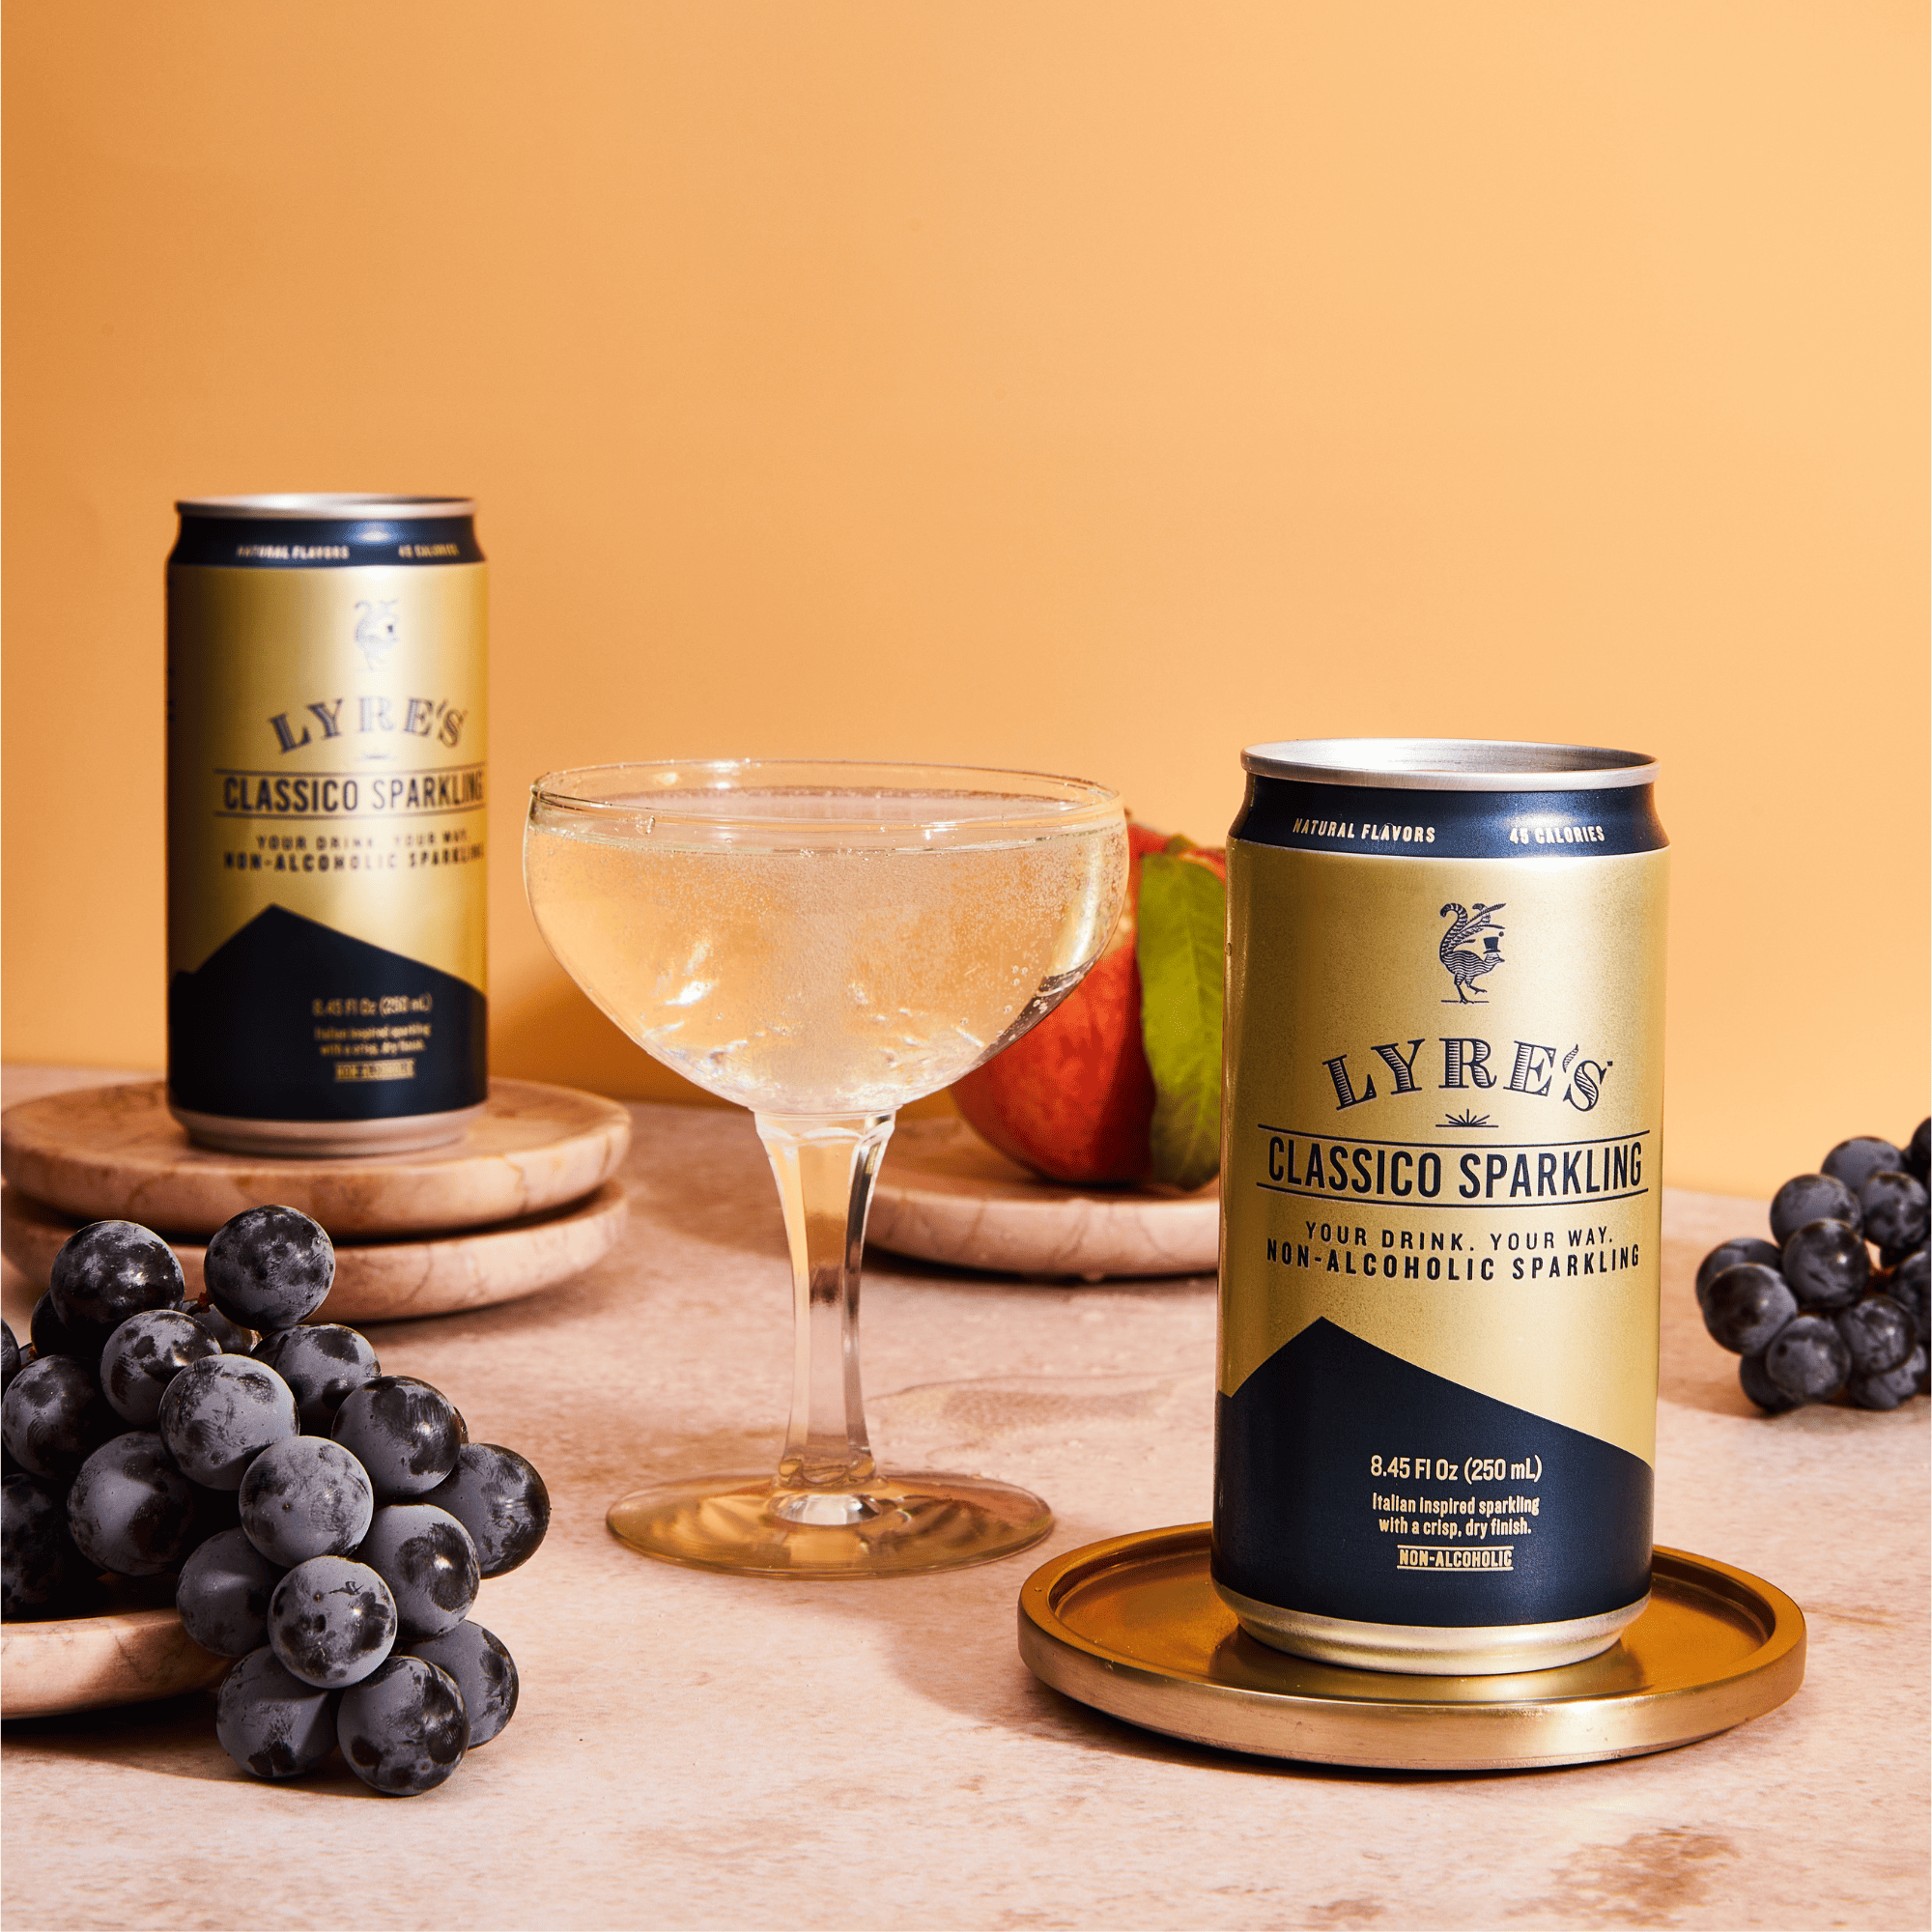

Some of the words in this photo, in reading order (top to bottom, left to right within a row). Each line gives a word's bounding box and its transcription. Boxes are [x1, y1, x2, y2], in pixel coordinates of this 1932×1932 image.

[223, 776, 358, 812] CLASSICO
[372, 770, 483, 810] SPARKLING
[256, 835, 307, 851] YOUR
[393, 830, 436, 847] YOUR
[1293, 817, 1354, 838] NATURAL
[1360, 824, 1435, 843] FLAVORS
[1509, 826, 1528, 844] 45
[1534, 825, 1605, 844] CALORIES
[223, 851, 397, 872] NON-ALCOHOLIC
[409, 842, 483, 867] SPARKL
[1322, 1037, 1607, 1112] LYRE'S
[1268, 1136, 1441, 1199] CLASSICO
[1459, 1141, 1642, 1199] SPARKLING
[1305, 1220, 1367, 1246] YOUR
[1381, 1229, 1474, 1251] DRINK.
[1490, 1231, 1554, 1251] YOUR
[1568, 1225, 1613, 1247] WAY.
[1266, 1237, 1495, 1281] NON-ALCOHOLIC
[1513, 1243, 1639, 1279] SPARKLING
[1370, 1454, 1410, 1479] 8.45
[1415, 1458, 1431, 1480] Fl
[1435, 1459, 1459, 1481] Oz
[1463, 1457, 1507, 1485] (250
[1510, 1454, 1543, 1483] mL)
[1372, 1492, 1416, 1513] Italian
[1419, 1496, 1475, 1518] inspired
[1478, 1494, 1540, 1518] sparkling
[1378, 1516, 1408, 1535] with
[1411, 1521, 1420, 1535] a
[1423, 1519, 1463, 1540] crisp,
[1465, 1518, 1488, 1540] dry
[1491, 1516, 1532, 1536] finish.
[1399, 1548, 1513, 1568] NON-ALCOHOLIC
